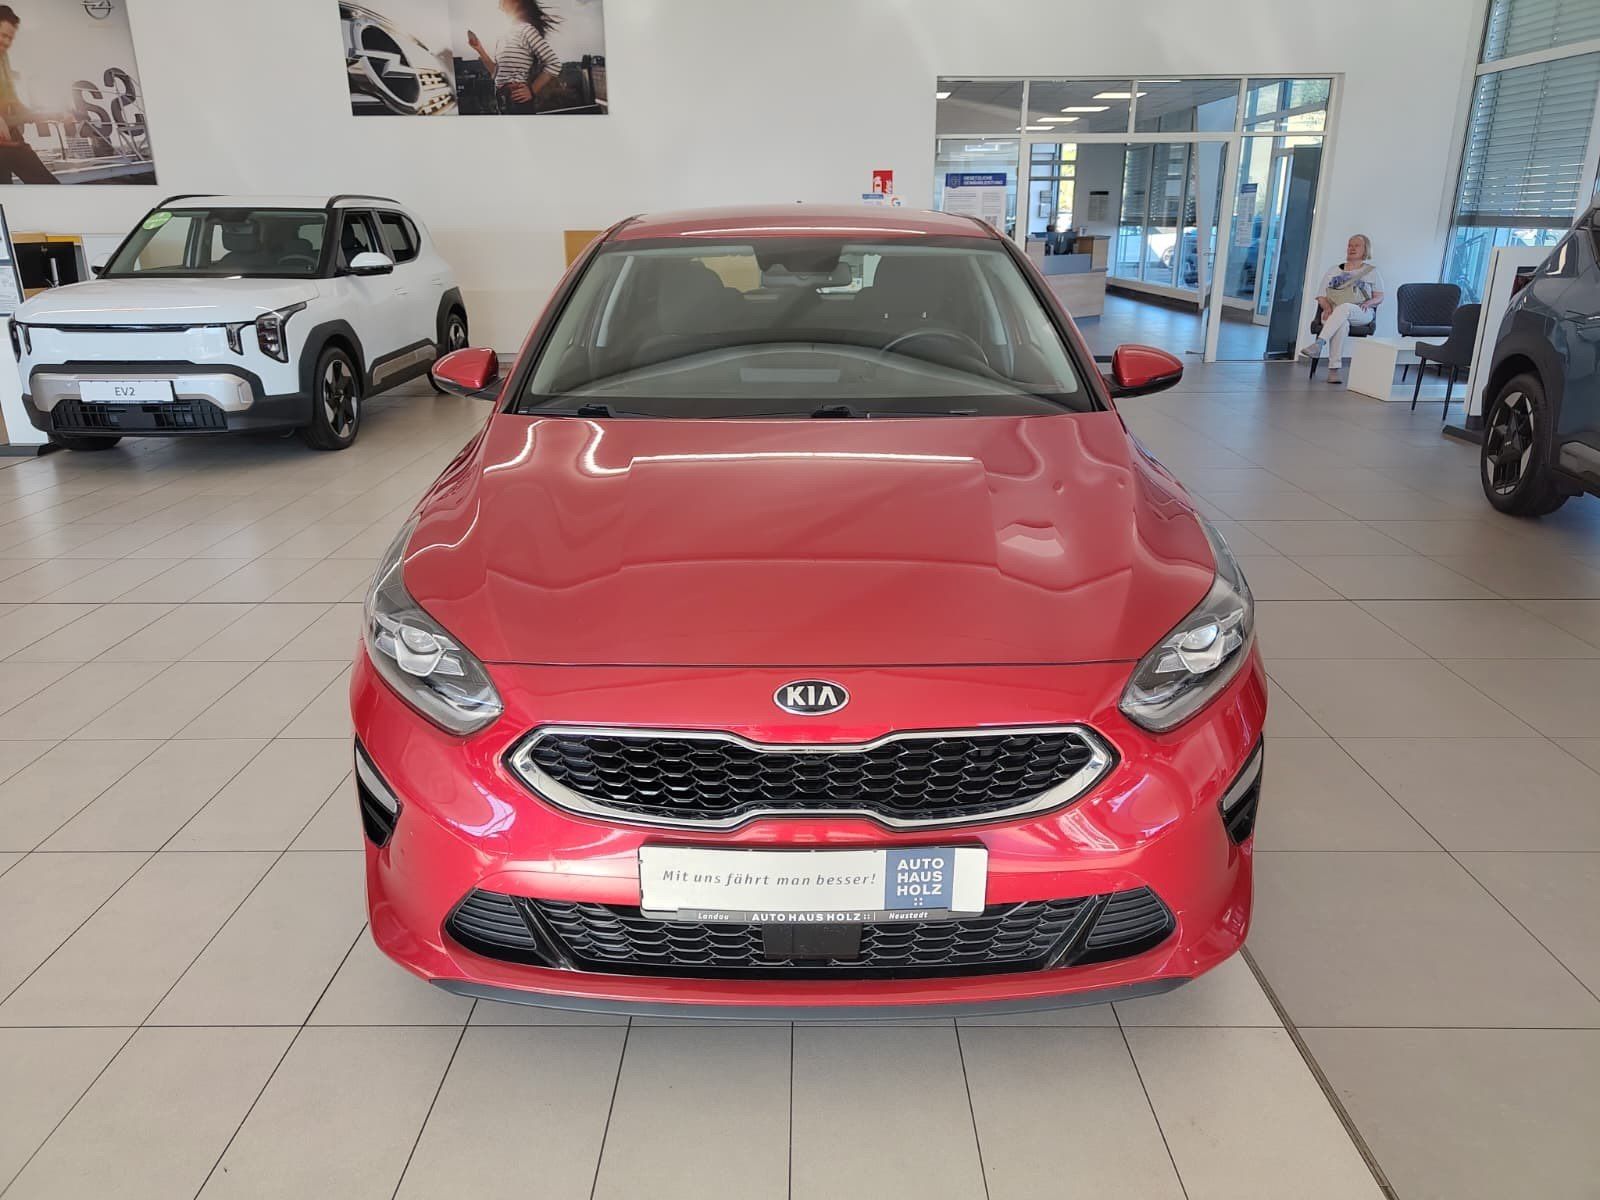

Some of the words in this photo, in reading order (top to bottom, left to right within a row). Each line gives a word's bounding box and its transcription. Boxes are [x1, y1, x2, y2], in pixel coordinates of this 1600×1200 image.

[114, 386, 136, 397] EV2
[786, 685, 839, 706] KIA
[897, 857, 945, 871] AUTO
[662, 869, 689, 883] Mit
[693, 875, 721, 884] uns
[724, 872, 770, 887] fährt
[776, 876, 811, 886] man
[816, 873, 876, 886] besser!
[897, 870, 943, 884] HAUS
[896, 883, 942, 896] HOLZ
[697, 911, 729, 921] Landau
[826, 912, 861, 922] HOLZ
[888, 910, 929, 920] Neustadt
